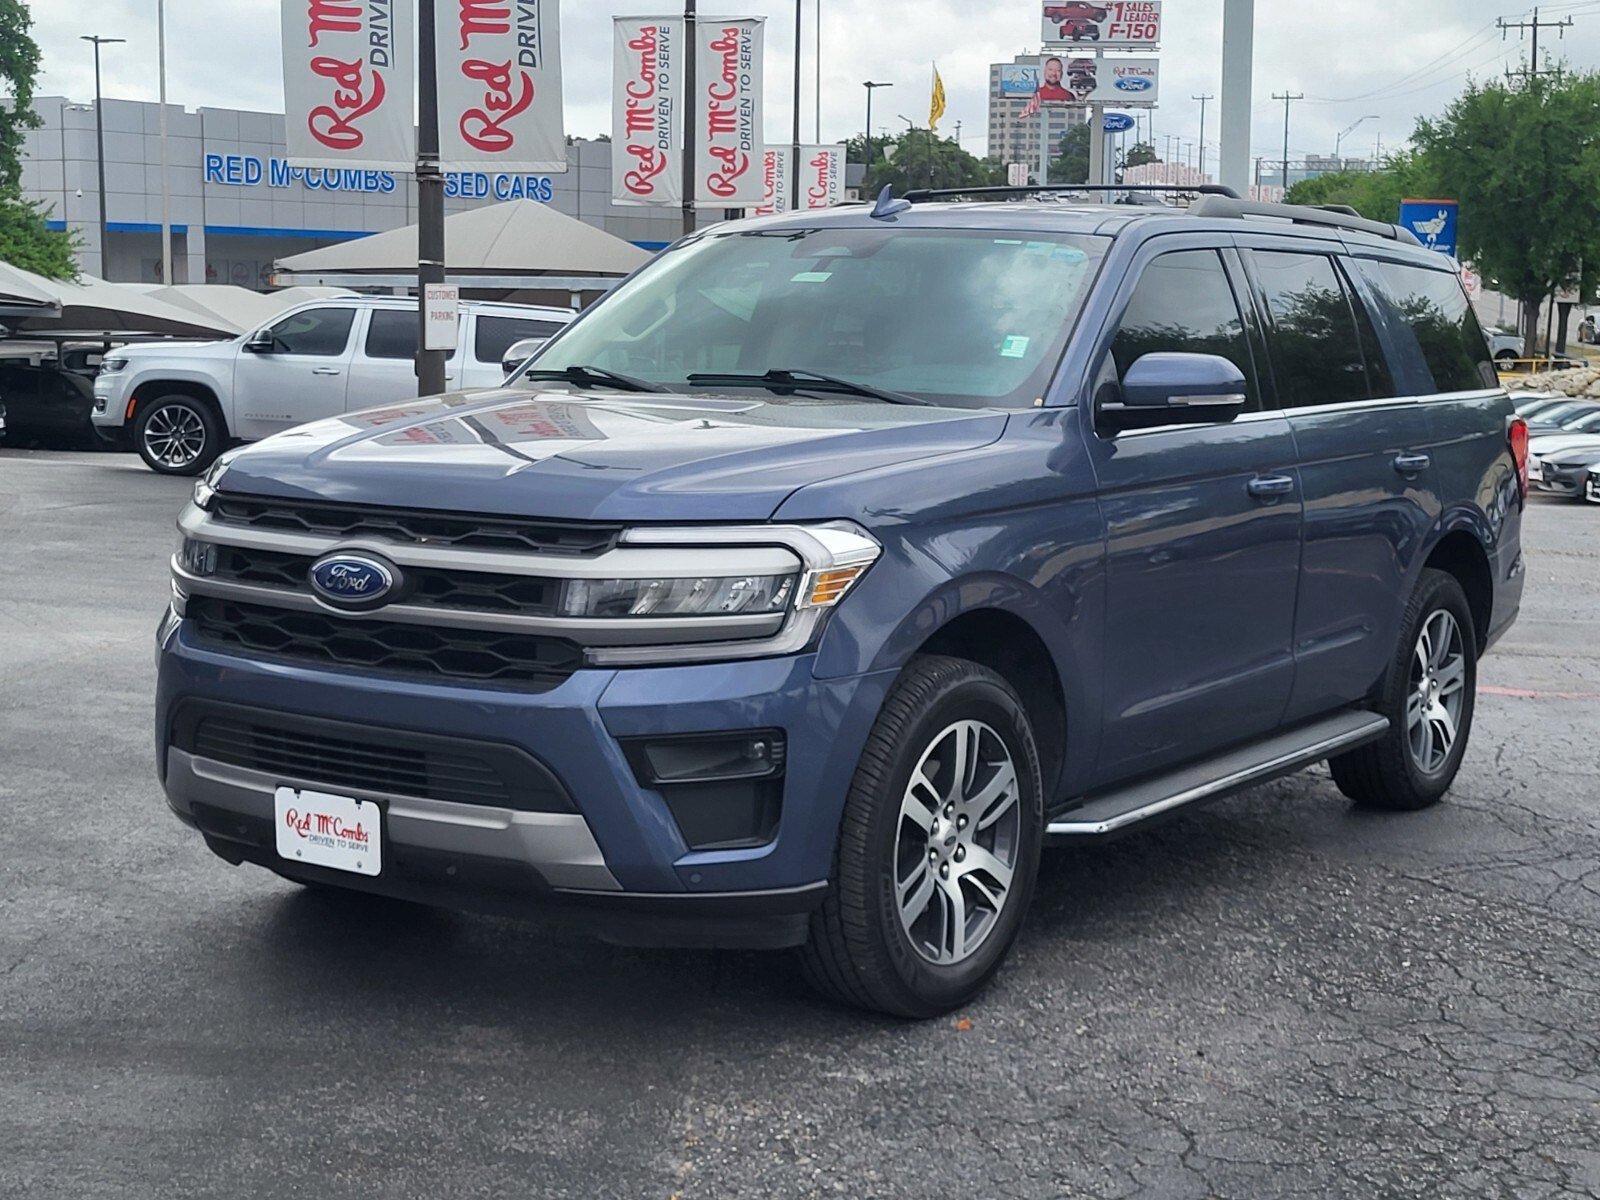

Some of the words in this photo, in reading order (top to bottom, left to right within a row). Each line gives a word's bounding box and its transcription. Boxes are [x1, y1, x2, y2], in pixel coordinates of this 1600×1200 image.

[1124, 13, 1160, 22] LEADER
[1126, 2, 1154, 12] SALES
[1108, 23, 1157, 39] F-150
[659, 26, 670, 68] SERVE
[741, 28, 752, 70] SERVE
[626, 26, 657, 140] McCombs
[659, 73, 670, 92] TO
[708, 27, 740, 142] McCombs
[741, 74, 751, 93] TO
[1120, 79, 1146, 90] Ford
[307, 56, 386, 150] Red
[459, 59, 535, 152] Red
[659, 97, 670, 150] DRIVEN
[741, 98, 751, 151] DRIVEN
[205, 154, 263, 185] RED
[444, 172, 489, 197] SED
[495, 174, 553, 201] CARS
[624, 144, 667, 195] Red
[707, 146, 749, 197] Red
[776, 152, 785, 180] SERVE
[829, 152, 838, 179] SERVE
[776, 182, 784, 193] TO
[829, 182, 837, 193] TO
[427, 290, 456, 300] CUSTOMER
[431, 311, 454, 321] PARKING
[325, 563, 371, 592] Ford
[286, 808, 311, 838] Red
[314, 813, 369, 843] McCombs
[309, 834, 335, 846] DRIVEN
[336, 839, 347, 848] TO
[348, 841, 369, 852] SERVE
